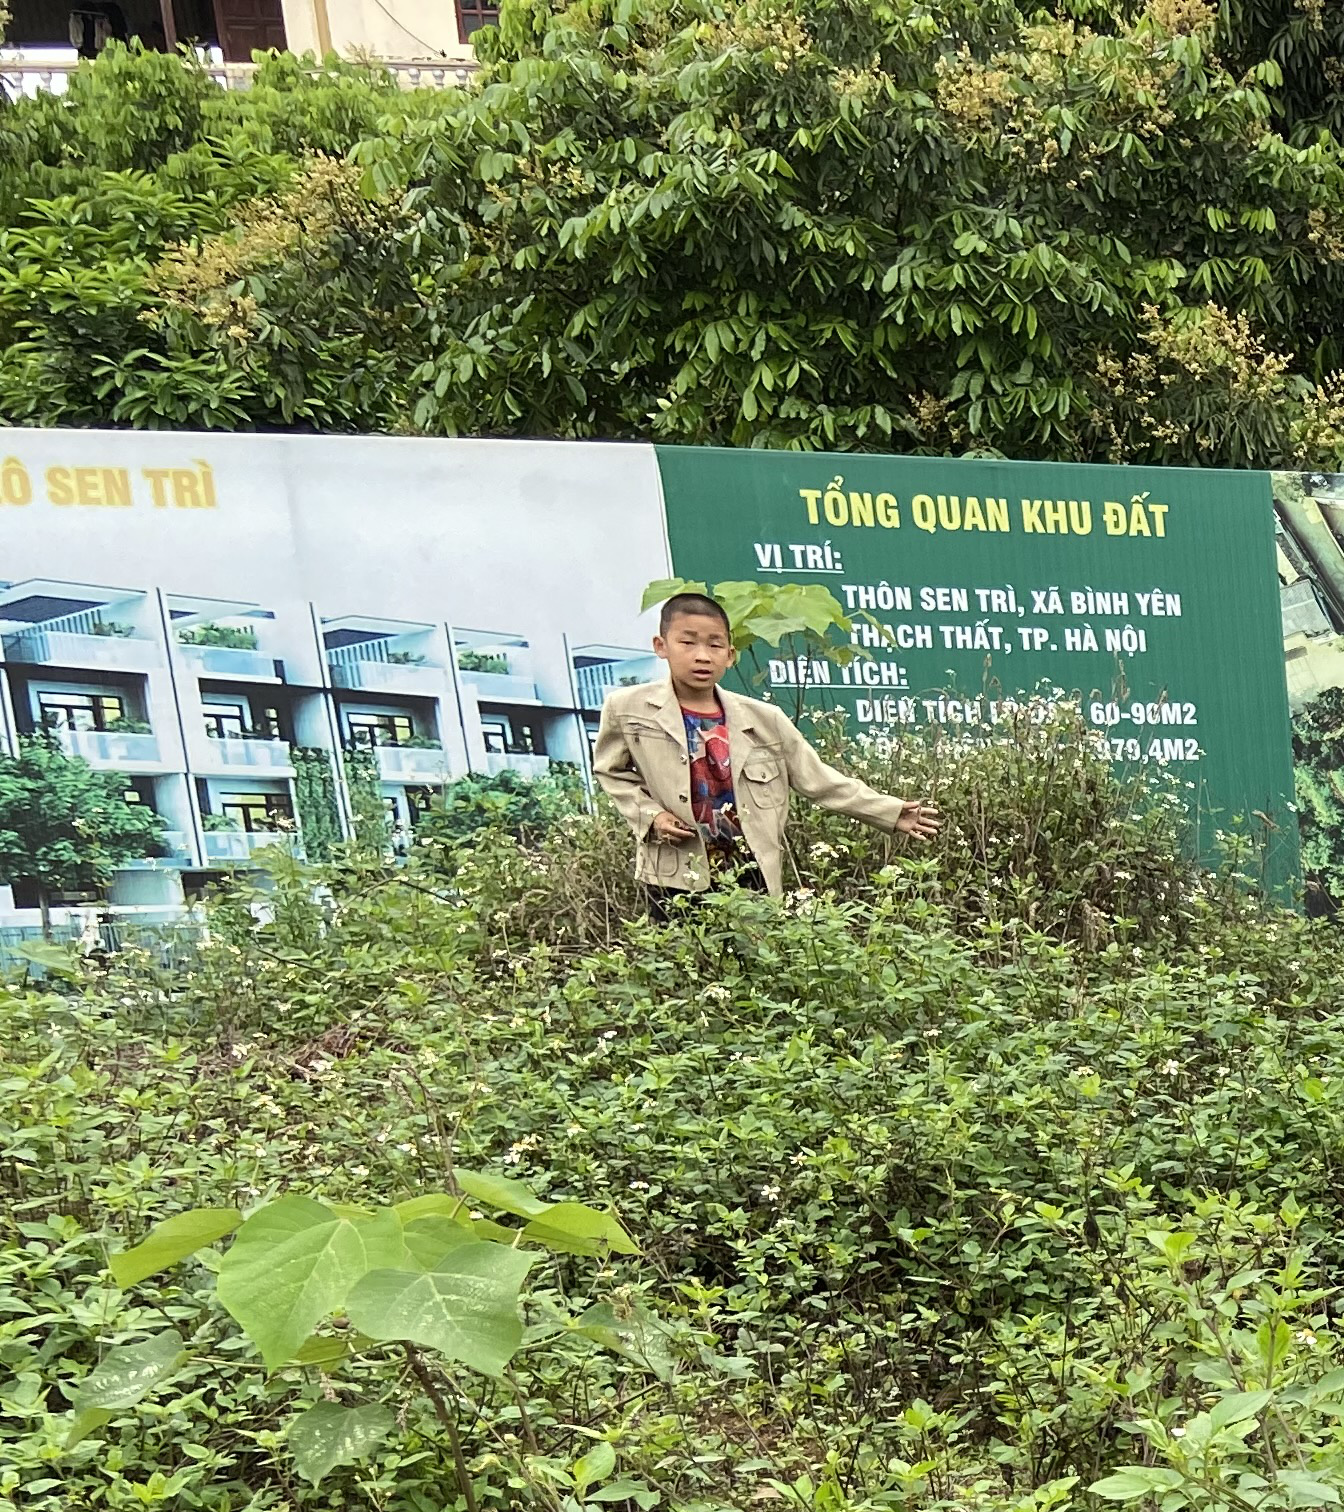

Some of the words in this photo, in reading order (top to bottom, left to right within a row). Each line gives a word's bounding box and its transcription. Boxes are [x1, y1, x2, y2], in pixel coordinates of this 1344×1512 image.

[45, 465, 133, 507] SEN
[142, 458, 218, 508] TRÌ
[799, 475, 900, 529] TỔNG
[911, 494, 1010, 535] QUAN
[1022, 499, 1092, 536] KHU
[1103, 491, 1169, 538] ĐẤT
[754, 543, 783, 573] VỊ
[788, 541, 844, 571] TRÍ:
[841, 581, 912, 612] THÔN
[920, 586, 969, 613] SEN
[975, 585, 1025, 617] TRÌ,
[1032, 586, 1063, 615] XÃ
[1070, 586, 1129, 617] BÌNH
[1136, 588, 1182, 617] YÊN
[850, 623, 933, 653] THẠCH
[939, 618, 1011, 654] THẤT,
[1018, 627, 1058, 651] TP.
[1064, 623, 1099, 652] HÀ
[1105, 624, 1147, 657] NỘI
[768, 655, 831, 688] DIỆN
[837, 656, 909, 687] TÍCH:
